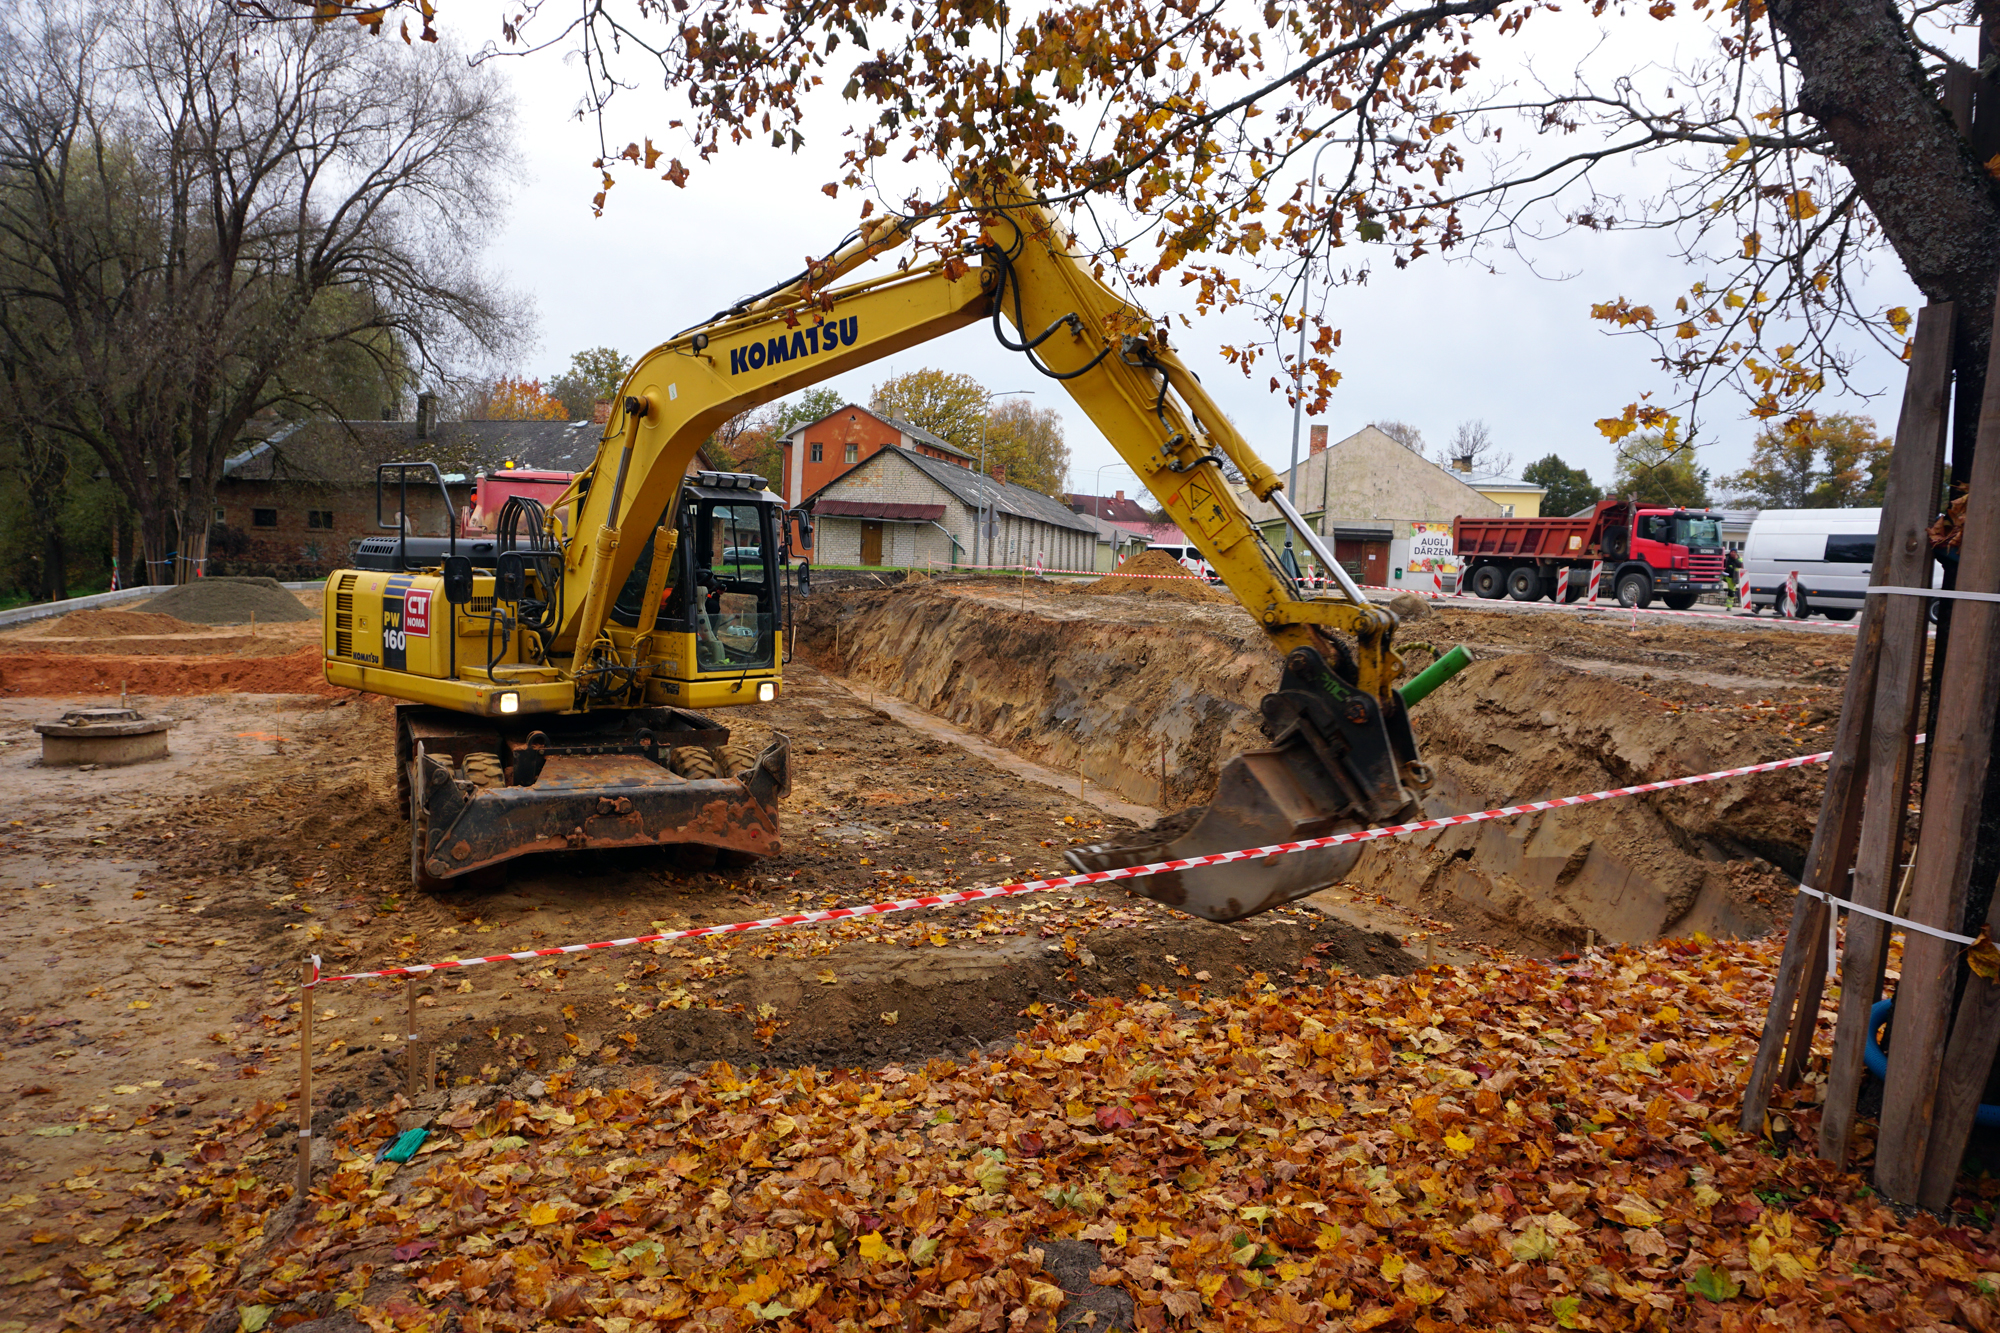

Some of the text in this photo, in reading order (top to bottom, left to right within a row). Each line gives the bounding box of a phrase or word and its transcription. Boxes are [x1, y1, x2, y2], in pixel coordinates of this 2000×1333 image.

[730, 315, 857, 375] KOMATSU
[1421, 538, 1448, 547] AUGĻI
[384, 611, 400, 627] PW
[407, 617, 425, 628] NOMA
[383, 629, 406, 651] 160
[353, 652, 379, 664] KOMATSU
